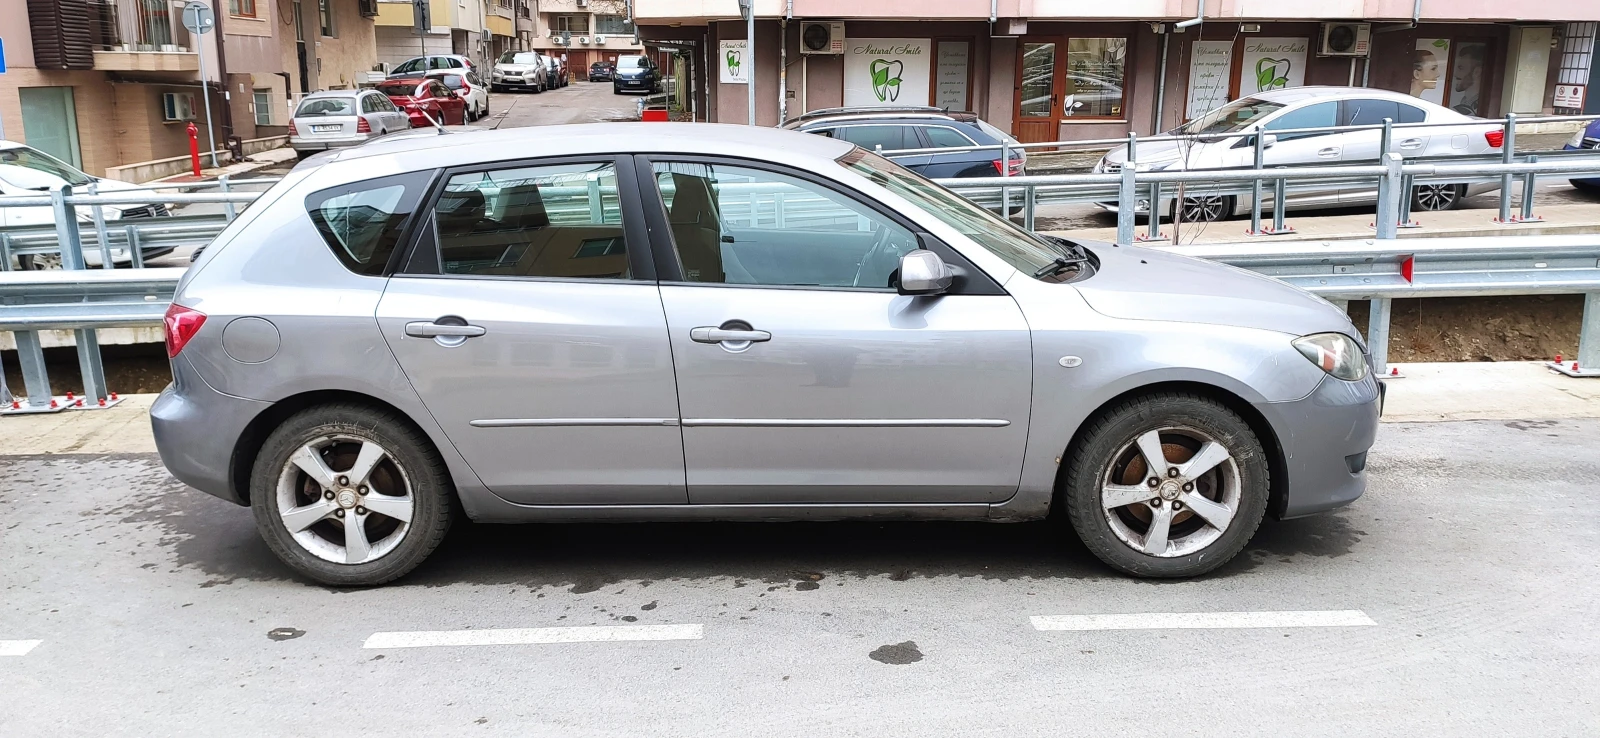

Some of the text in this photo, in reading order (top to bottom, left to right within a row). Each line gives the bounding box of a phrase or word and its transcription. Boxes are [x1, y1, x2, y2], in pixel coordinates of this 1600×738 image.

[853, 43, 922, 55] Natural Smile
[1245, 42, 1306, 53] Natural Smile
